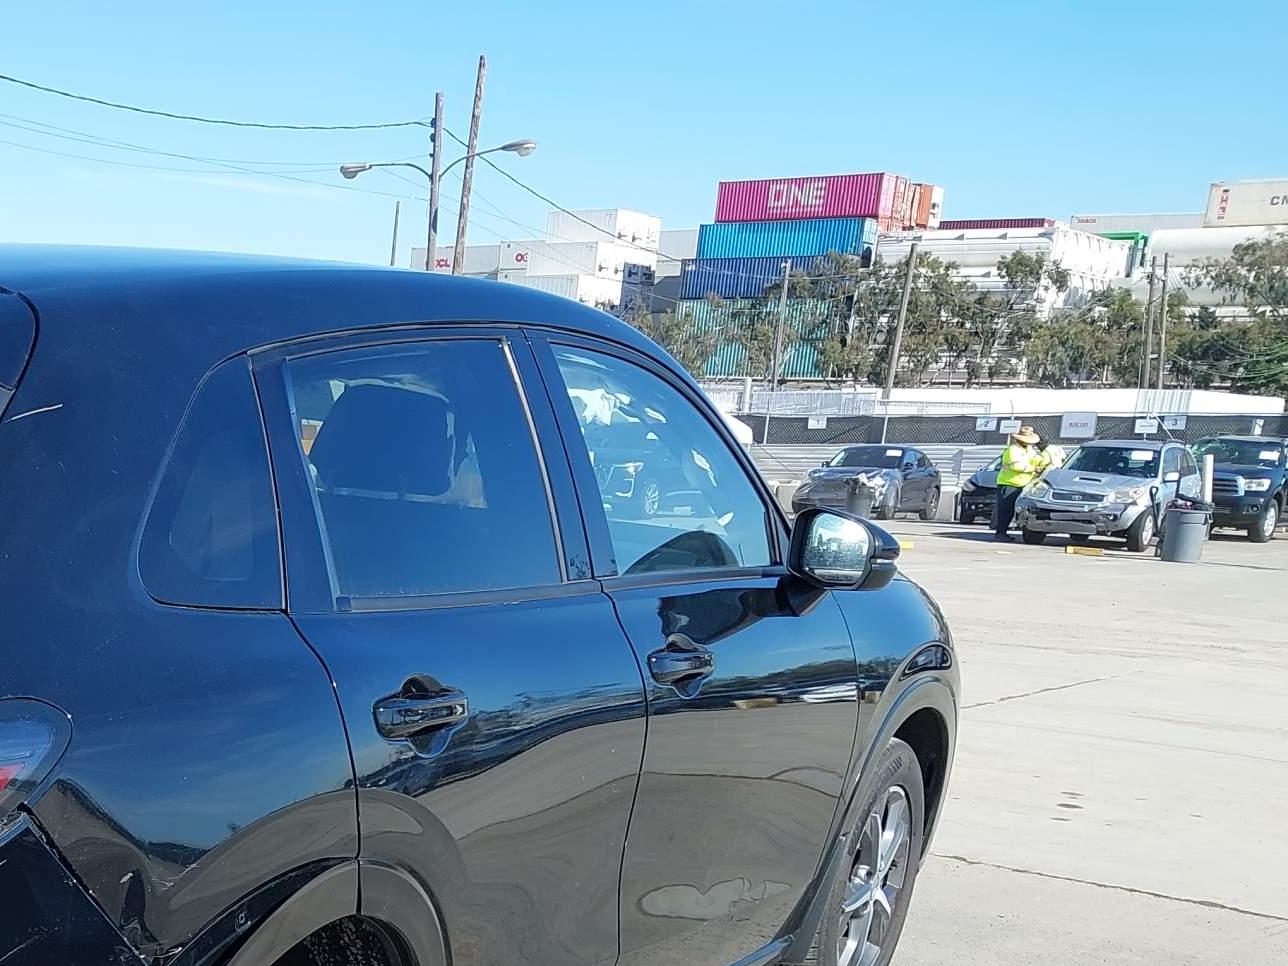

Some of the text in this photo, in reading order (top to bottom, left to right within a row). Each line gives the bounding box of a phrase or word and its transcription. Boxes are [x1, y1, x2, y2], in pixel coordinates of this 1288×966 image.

[767, 180, 826, 209] ONE
[983, 419, 990, 428] 2
[1171, 418, 1178, 427] 3
